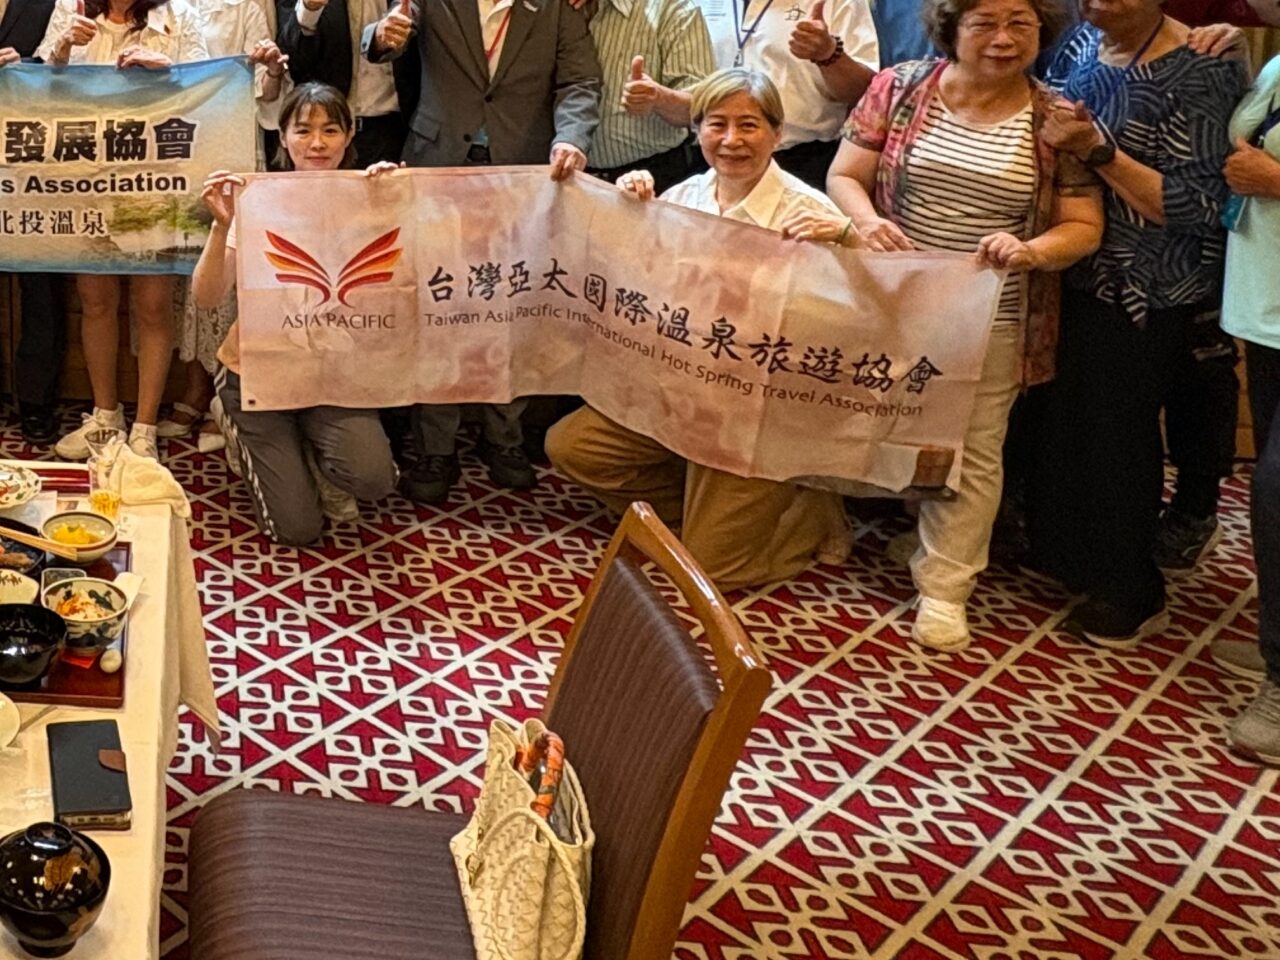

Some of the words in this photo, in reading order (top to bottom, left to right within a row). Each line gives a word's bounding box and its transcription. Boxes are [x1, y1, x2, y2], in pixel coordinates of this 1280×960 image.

[24, 172, 187, 194] Association
[281, 313, 322, 329] ASIA
[325, 312, 396, 329] PACIFIC
[424, 312, 481, 326] Taiwan
[516, 303, 561, 319] Pacific
[566, 307, 656, 358] International
[661, 349, 692, 375] Hot
[695, 364, 754, 396] Spring
[760, 382, 816, 404] Travel
[819, 392, 923, 418] Association
